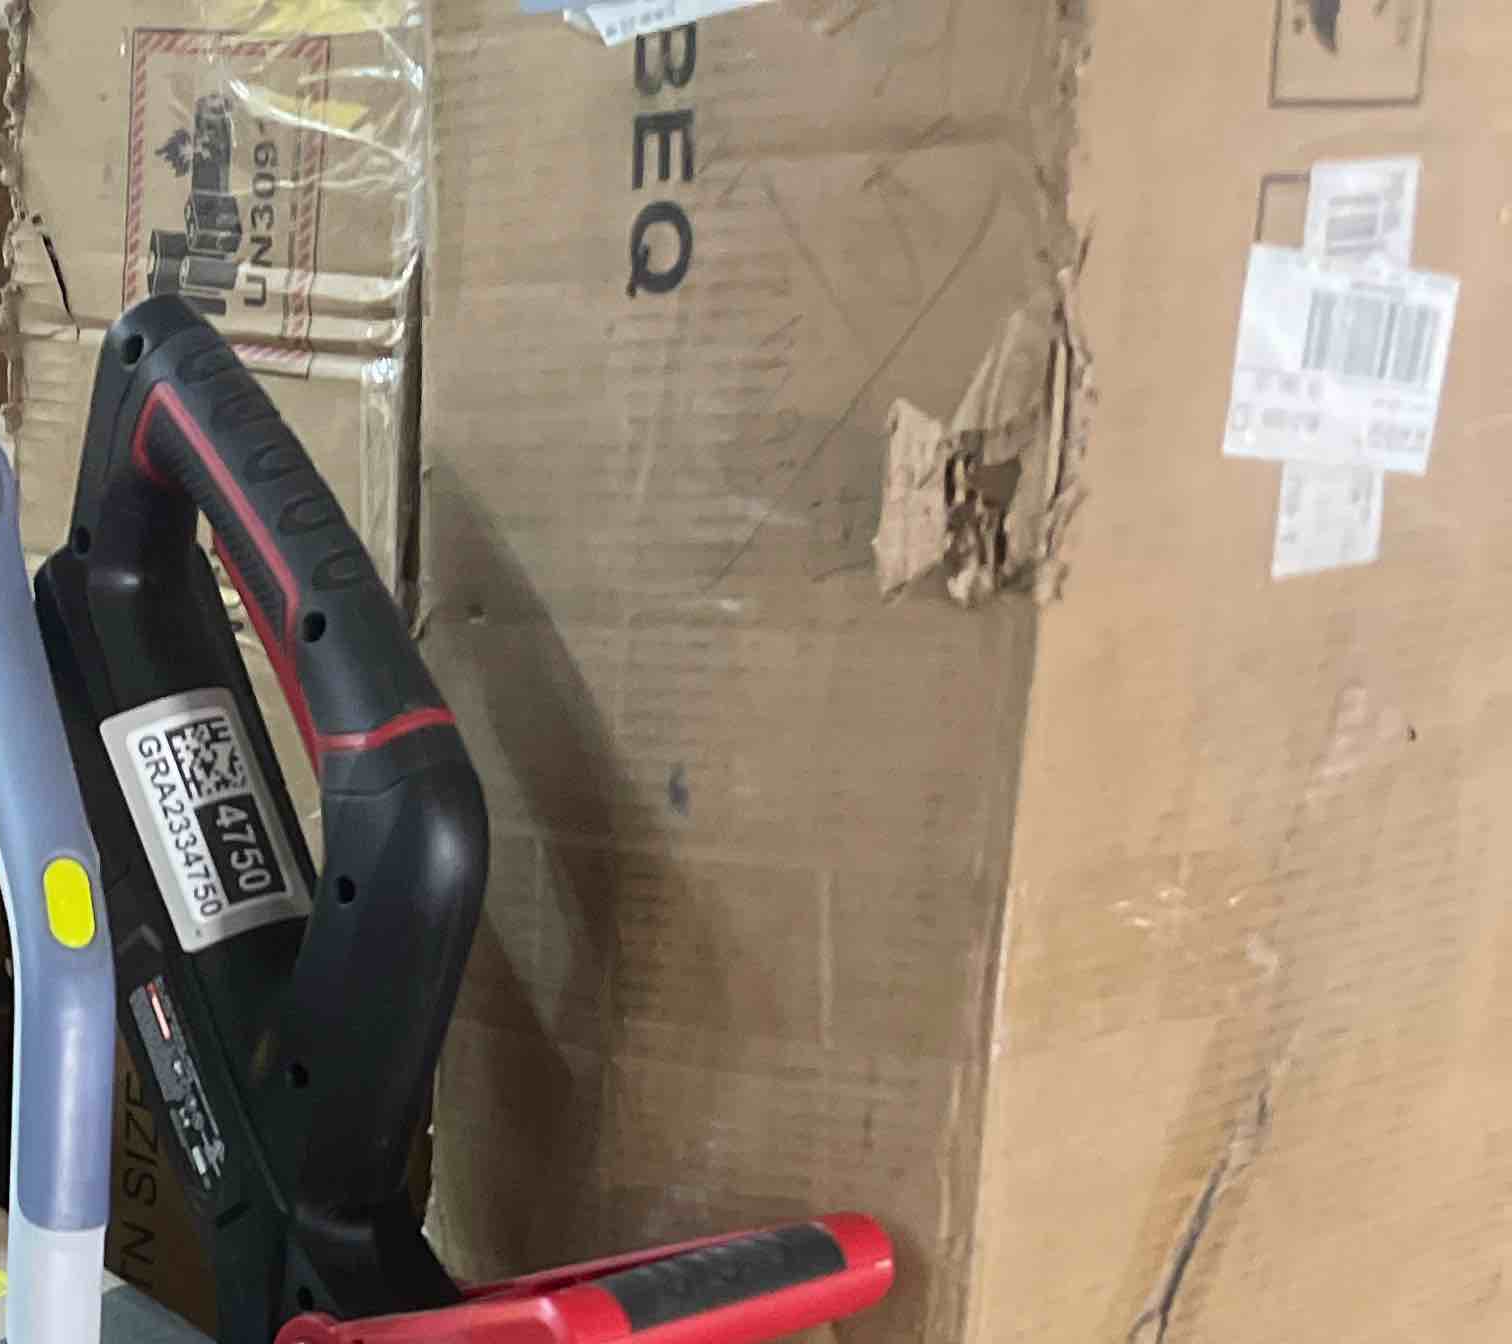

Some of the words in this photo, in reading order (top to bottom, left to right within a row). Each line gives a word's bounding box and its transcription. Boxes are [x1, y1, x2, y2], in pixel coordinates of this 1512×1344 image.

[243, 118, 279, 308] UN309
[139, 735, 222, 916] GRA2334750
[216, 804, 272, 893] 4750
